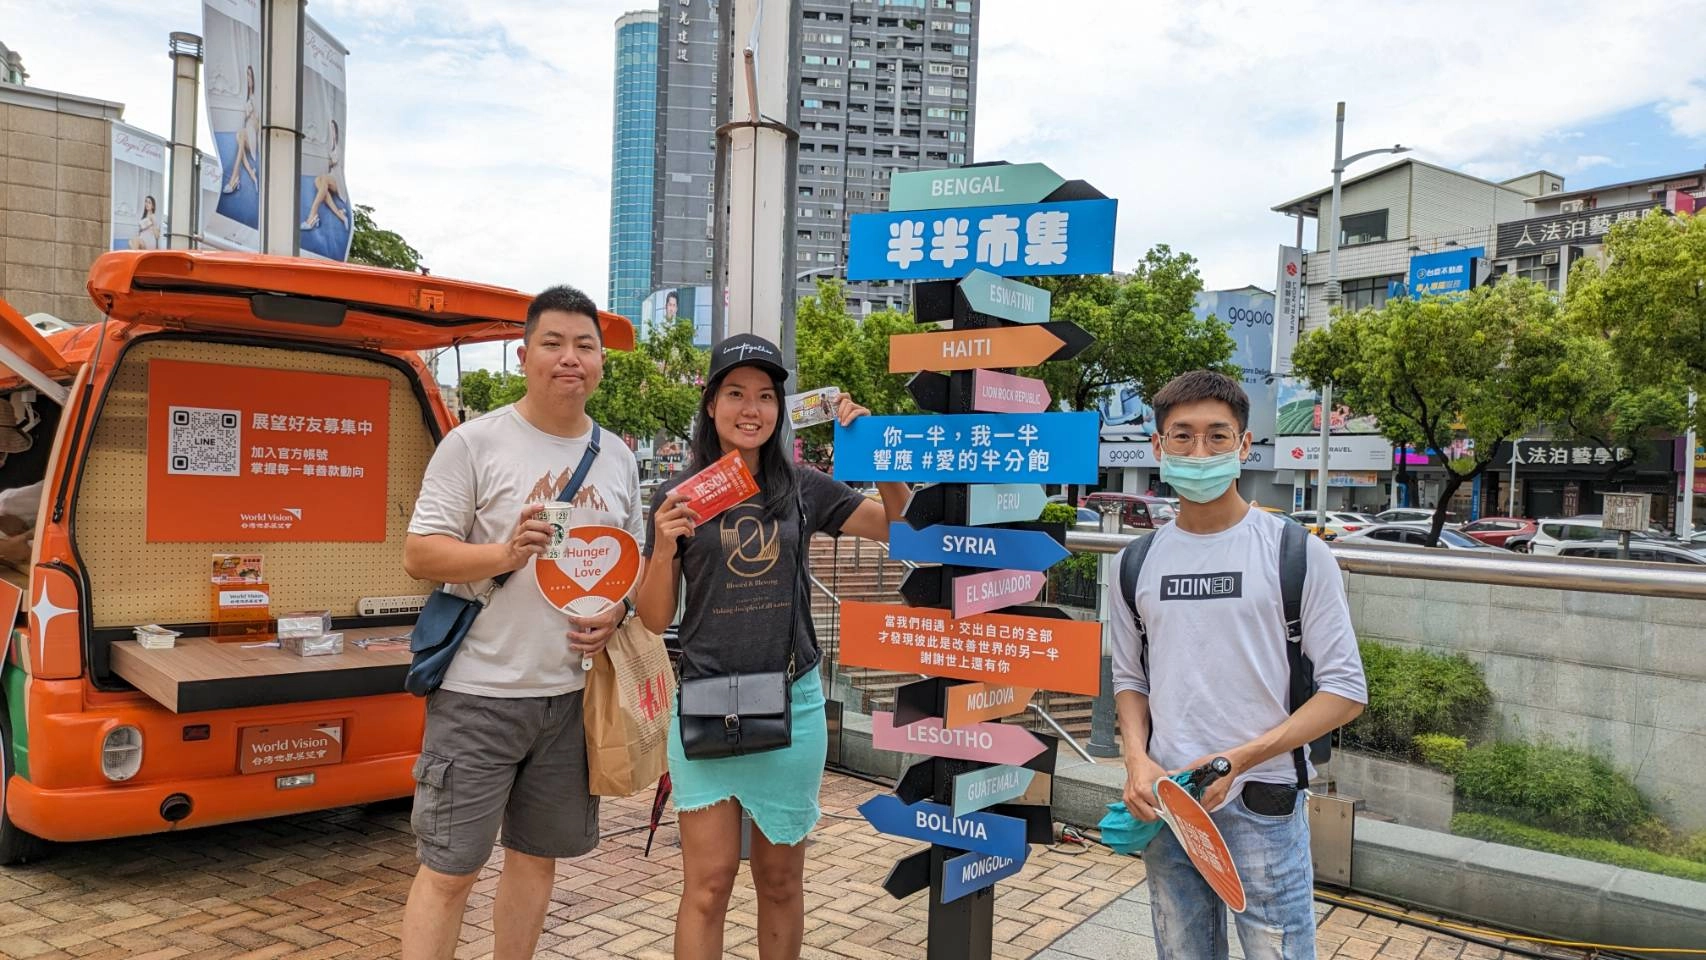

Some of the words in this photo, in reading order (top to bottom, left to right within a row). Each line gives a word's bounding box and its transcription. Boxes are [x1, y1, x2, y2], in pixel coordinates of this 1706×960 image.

[931, 175, 1004, 197] BENGAL
[887, 211, 1069, 270] 半半市集
[990, 284, 1035, 313] ESWATINI
[1228, 306, 1273, 328] gogoro
[942, 338, 991, 358] HAITI
[983, 385, 998, 399] LION
[998, 387, 1014, 401] ROCK
[1015, 390, 1041, 405] REPUBLIC
[252, 412, 373, 437] 展望好友募集中
[883, 423, 1039, 448] 你一半，我一半
[194, 438, 216, 446] LINE
[250, 446, 329, 462] 加入官方帳號
[873, 450, 913, 471] 響應
[922, 449, 1050, 472] #愛的半分飽
[1110, 449, 1145, 462] gogoro
[250, 462, 364, 479] 掌握每一筆善款動向
[997, 493, 1020, 511] PERU
[240, 513, 266, 521] World
[268, 513, 293, 521] Vision
[567, 547, 610, 559] Hunger
[942, 535, 997, 556] SYRIA
[574, 567, 602, 578] Love
[966, 585, 978, 603] EL
[981, 575, 1031, 598] SALVADOR
[1168, 576, 1234, 596] JOINED
[884, 615, 1053, 643] 當我們相遇，交出自己的全部
[878, 631, 1059, 661] 才發現彼此是改善世界的另一半
[920, 651, 1010, 674] 謝謝世上還有你
[967, 687, 1014, 711] MOLDOVA
[251, 739, 289, 754] World
[291, 737, 328, 749] Vision
[908, 725, 993, 749] LESOTHO
[968, 771, 1019, 800] GUATEMALA
[916, 811, 988, 841] BOLIVIA
